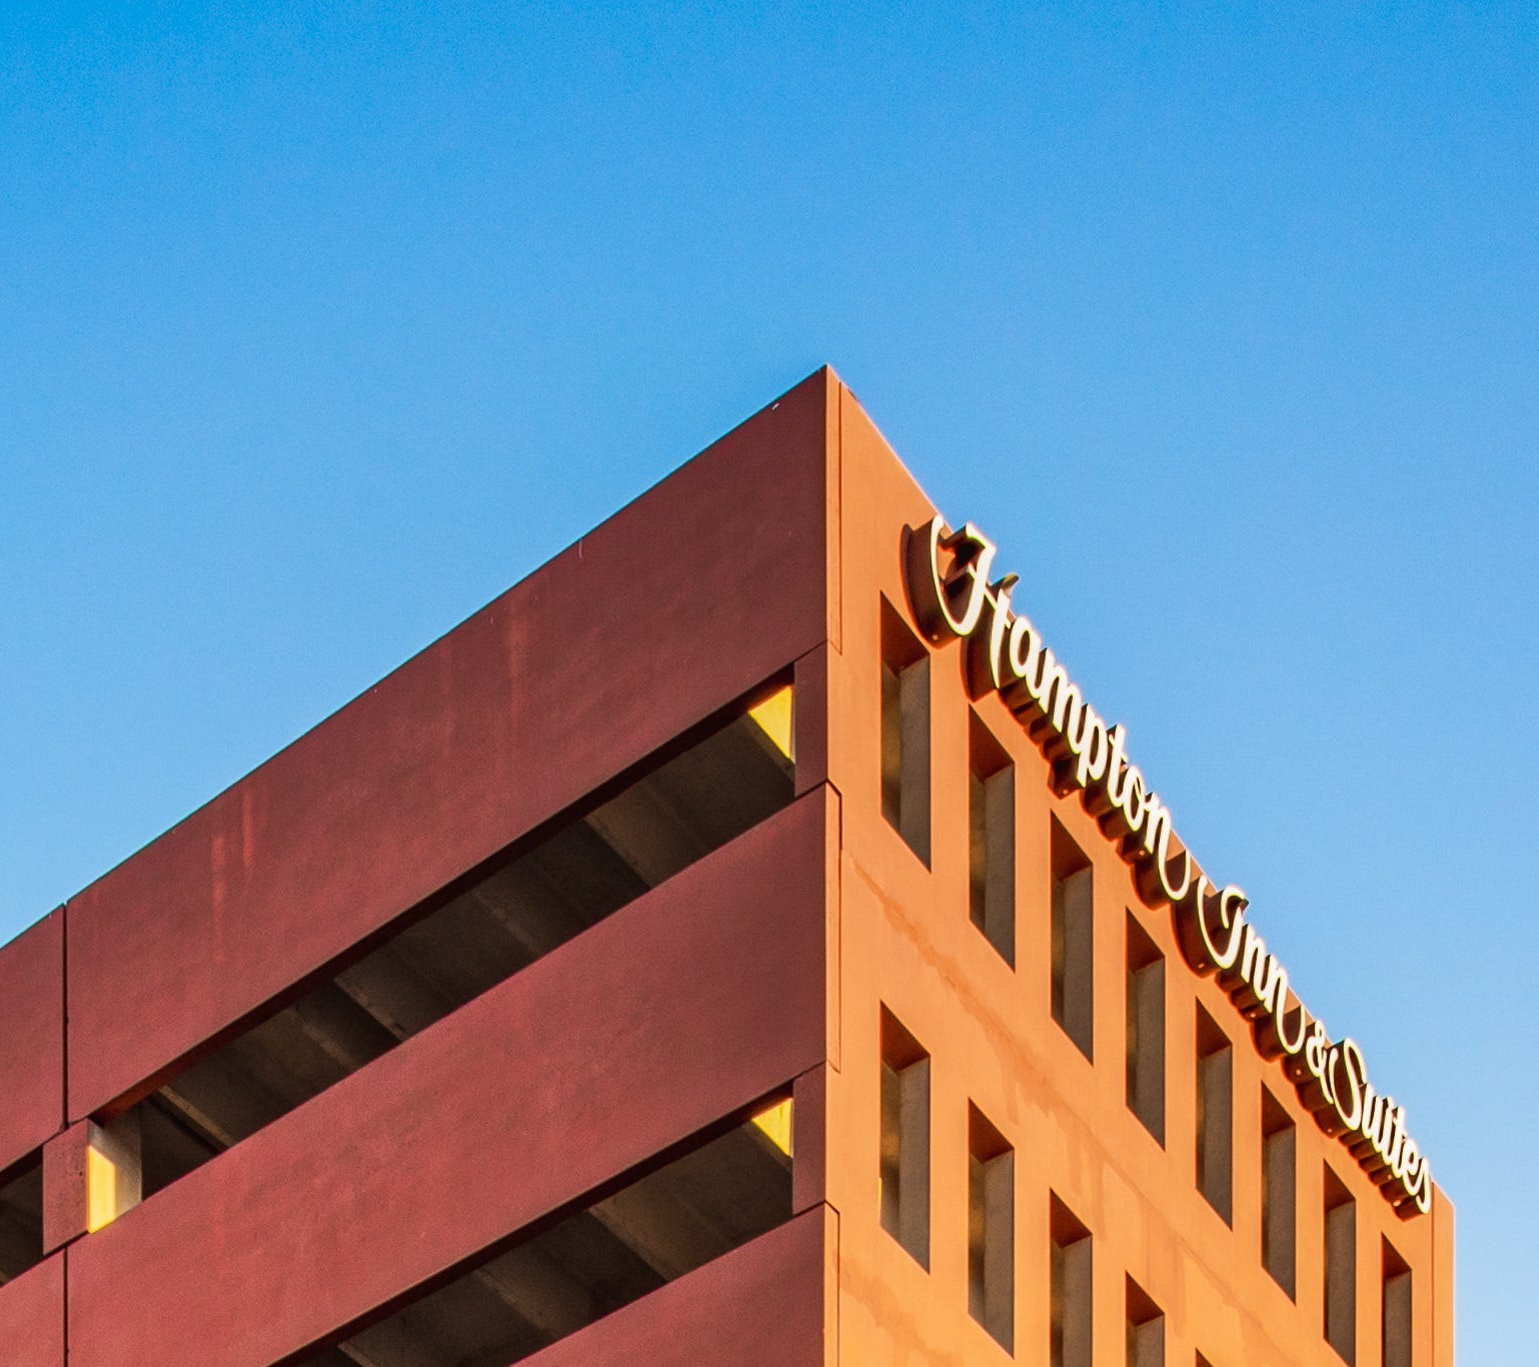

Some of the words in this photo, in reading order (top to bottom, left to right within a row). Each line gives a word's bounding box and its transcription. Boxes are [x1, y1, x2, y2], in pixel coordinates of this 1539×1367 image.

[929, 514, 1191, 901] Hampton
[1197, 873, 1306, 1056] Inn
[1328, 1037, 1431, 1214] Suites
